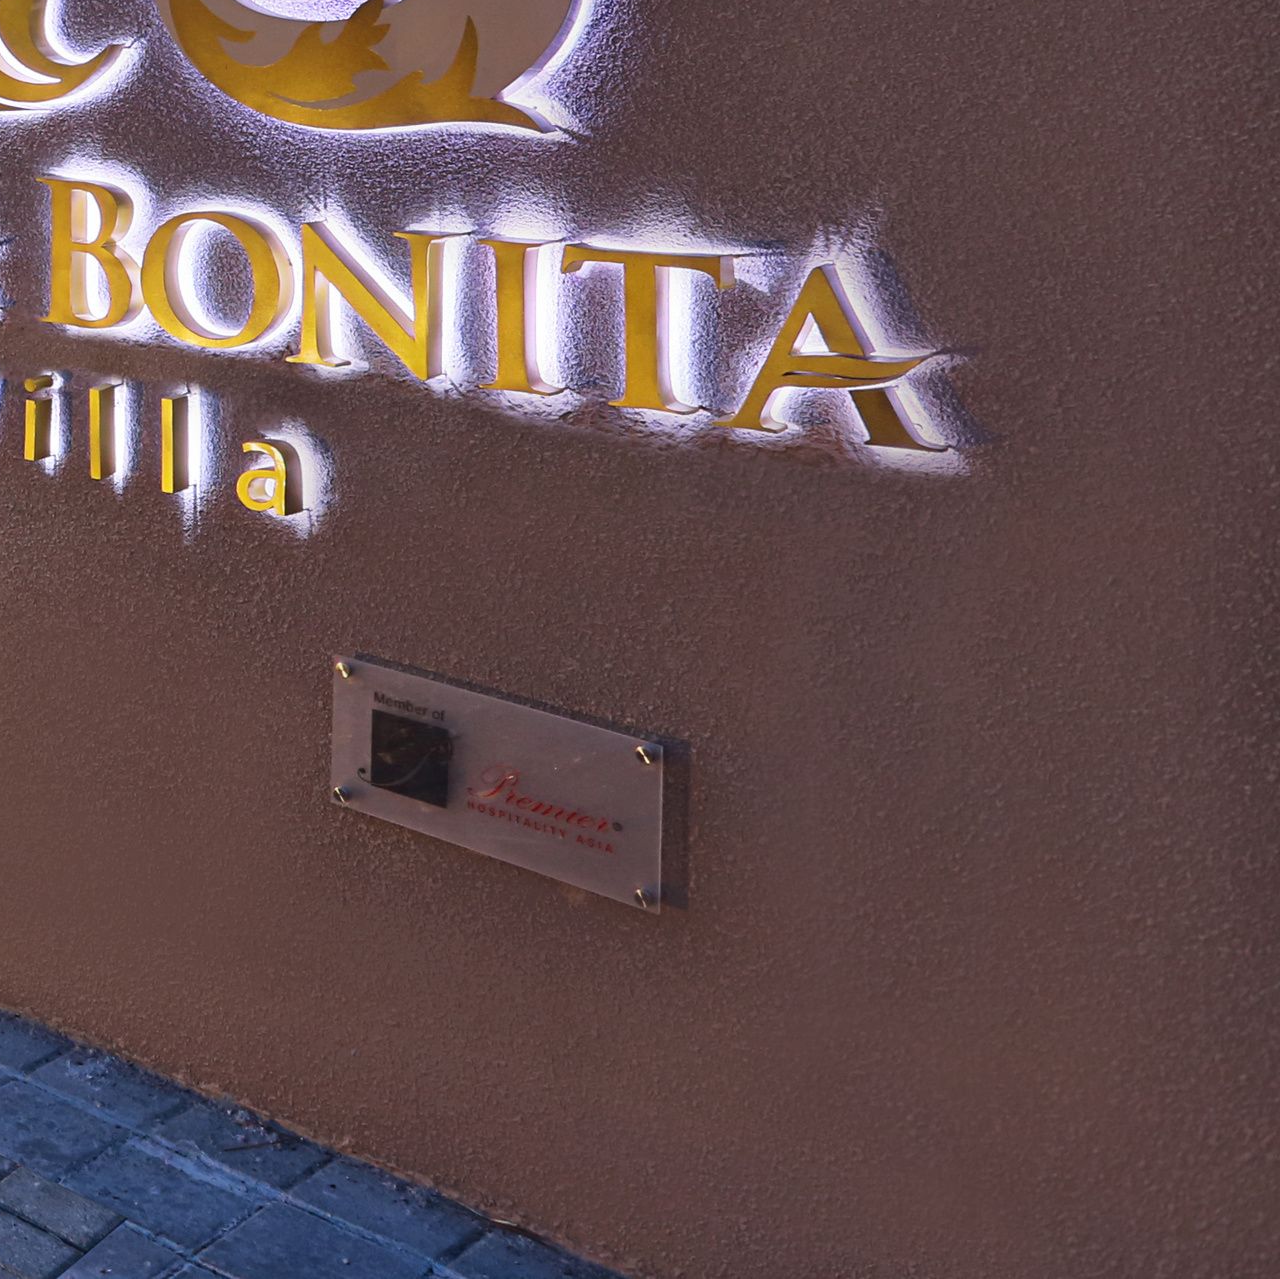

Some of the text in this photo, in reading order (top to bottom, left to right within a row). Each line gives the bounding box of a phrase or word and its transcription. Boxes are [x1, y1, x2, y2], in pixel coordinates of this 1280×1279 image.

[37, 176, 952, 453] BONITA
[373, 690, 446, 722] Member of
[466, 763, 609, 833] Premier
[466, 800, 615, 855] HOSPITALITY ASIA
